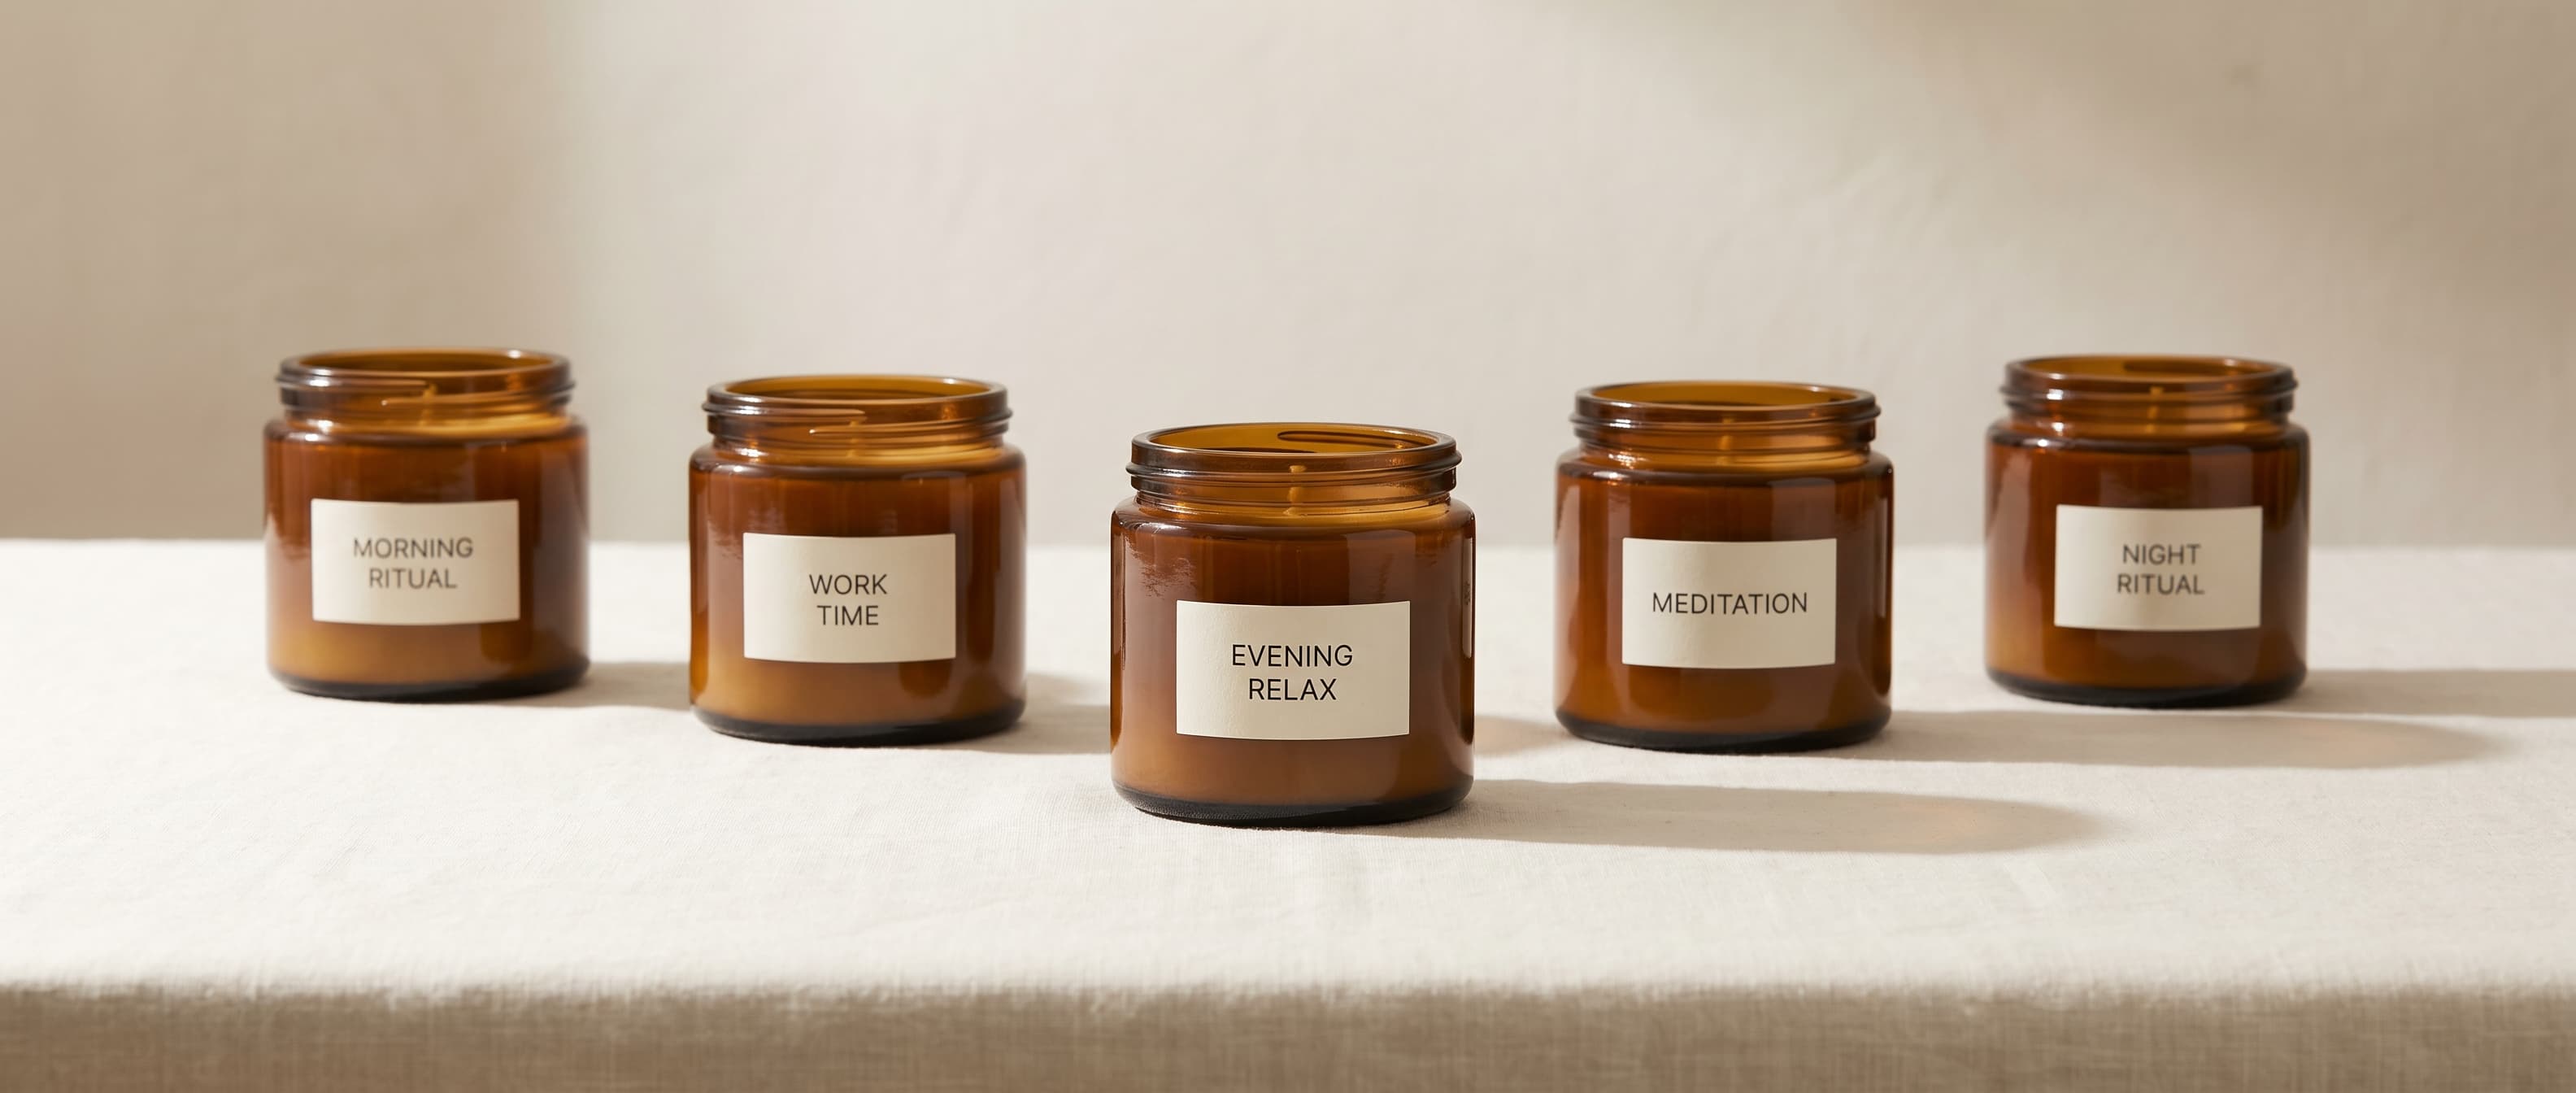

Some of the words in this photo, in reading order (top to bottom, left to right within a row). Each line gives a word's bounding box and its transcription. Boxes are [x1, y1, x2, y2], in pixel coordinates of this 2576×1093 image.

[353, 538, 474, 559] MORNING
[2121, 544, 2201, 565] NIGHT
[368, 568, 457, 590] RITUAL
[808, 573, 888, 595] WORK
[2117, 573, 2204, 595] RITUAL
[1652, 591, 1808, 615] MEDITATION
[816, 604, 879, 626] TIME
[1232, 643, 1353, 668] EVENING
[1249, 677, 1337, 701] RELAX
